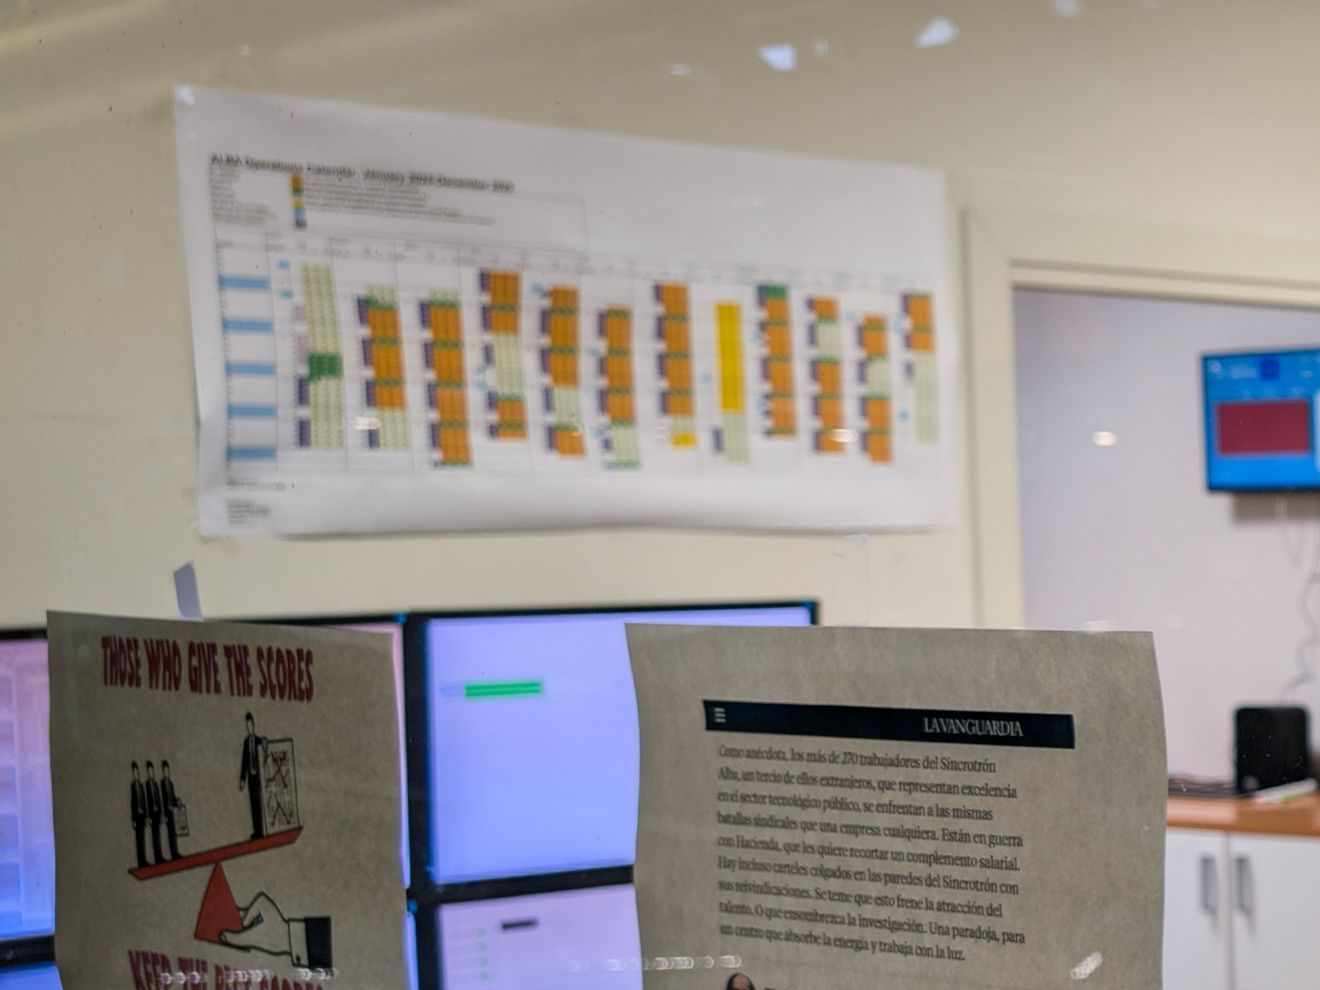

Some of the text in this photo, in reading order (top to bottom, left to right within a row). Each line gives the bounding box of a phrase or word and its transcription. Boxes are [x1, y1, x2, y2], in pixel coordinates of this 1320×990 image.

[102, 635, 314, 703] THOSE WHO GIVE THE SCORES
[718, 744, 996, 773] Como anécdota, los más de 270 trabajadores del Sincrotrón
[718, 767, 1017, 799] Alba, un tercio de ellos extranjeros, que representan excelencia
[718, 791, 993, 820] en el sector tecnológico público, se enfrentan a las mismas
[717, 811, 1023, 848] batallas sindicales que una empresa cualquiera. Están en guerra
[718, 835, 1020, 871] con Hacienda, que les quiere recortar un complemento salarial.
[718, 855, 1018, 895] Hay incluso carteles colgados en las paredes del Sincrotrón con
[735, 881, 1002, 917] reivindicaciones. Se teme que esto frene la atracción del
[756, 904, 1025, 945] O que ensombrezca la investigación. Una paradoja, para
[765, 928, 966, 961] que absorbe la energía y trabaja con la luz.
